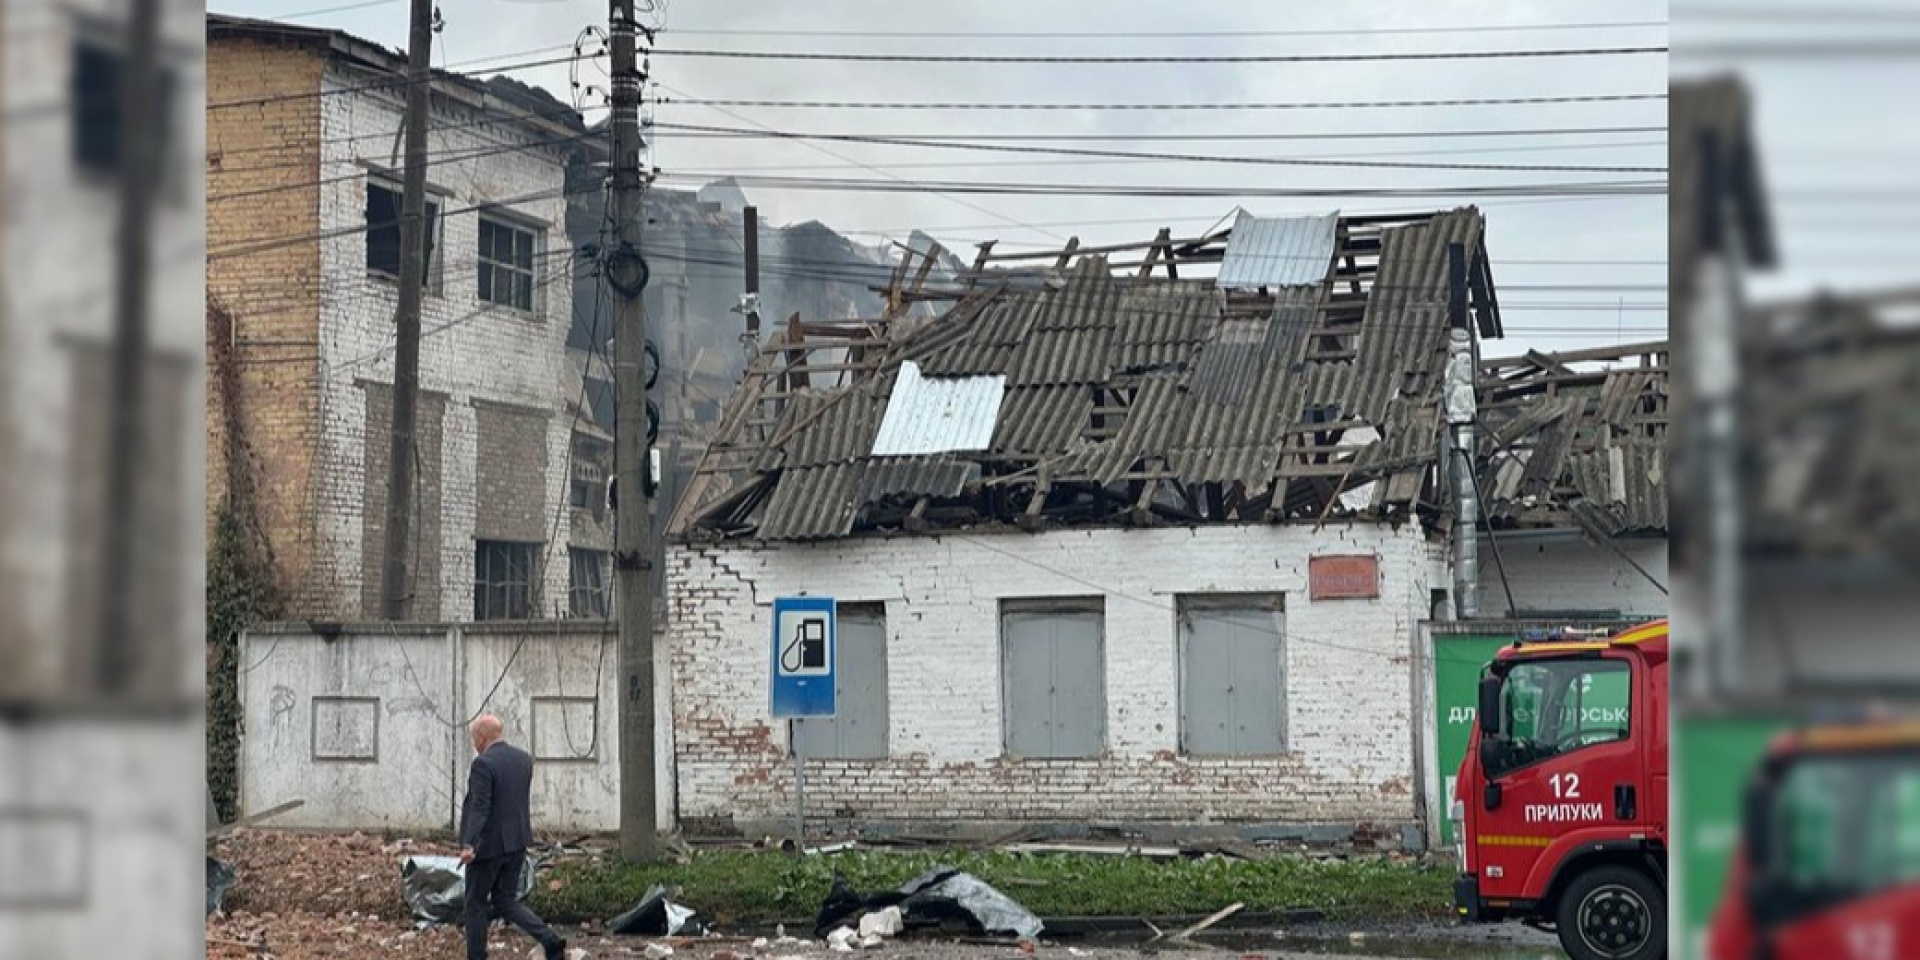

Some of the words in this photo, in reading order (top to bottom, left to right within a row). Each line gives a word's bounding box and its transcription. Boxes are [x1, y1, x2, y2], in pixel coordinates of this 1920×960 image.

[1449, 707, 1476, 724] дл
[1549, 772, 1580, 798] 12
[1524, 803, 1603, 822] ПРИЛУКИ
